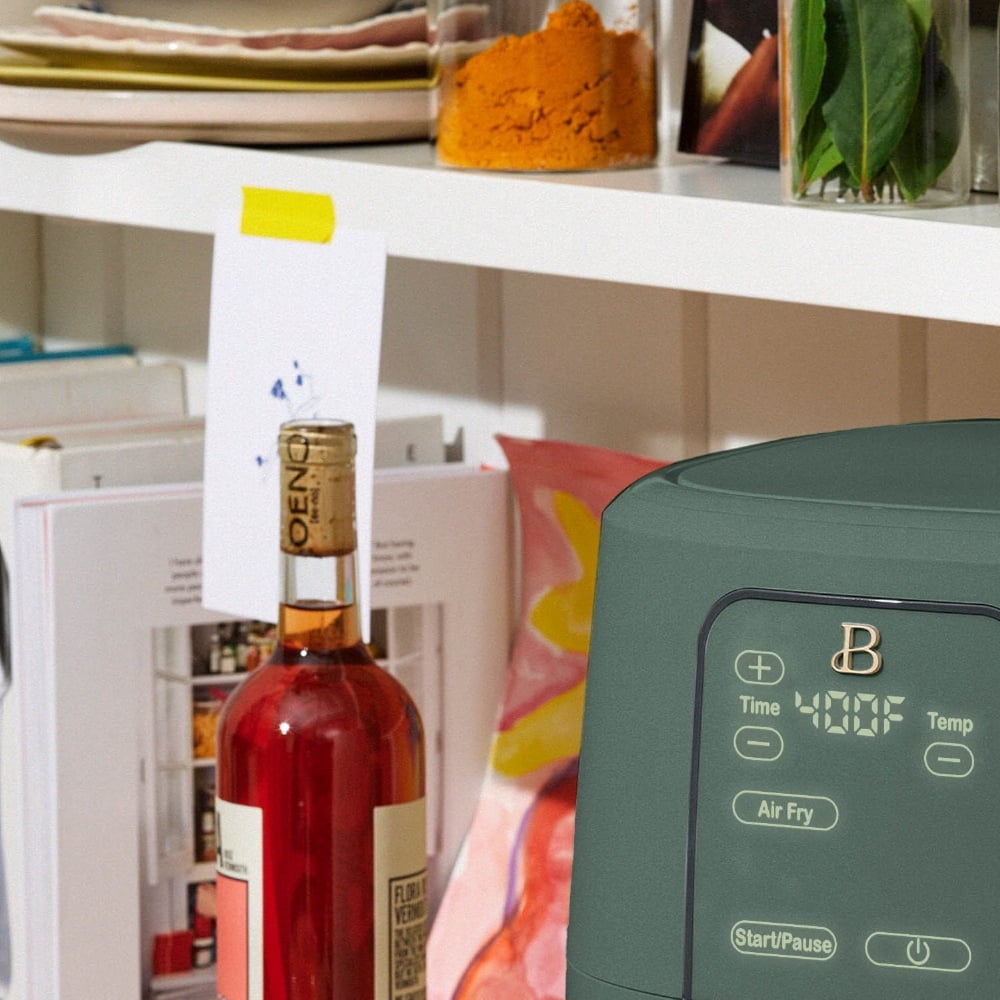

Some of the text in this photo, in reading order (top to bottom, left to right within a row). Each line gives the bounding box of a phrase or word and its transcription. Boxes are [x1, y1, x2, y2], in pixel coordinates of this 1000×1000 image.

[286, 433, 310, 547] OENO
[830, 621, 884, 676] B
[739, 695, 781, 717] Time
[794, 690, 906, 737] 400F
[926, 711, 974, 737] Temp
[758, 799, 814, 827] Air Fry
[734, 928, 834, 954] Start/Pause
